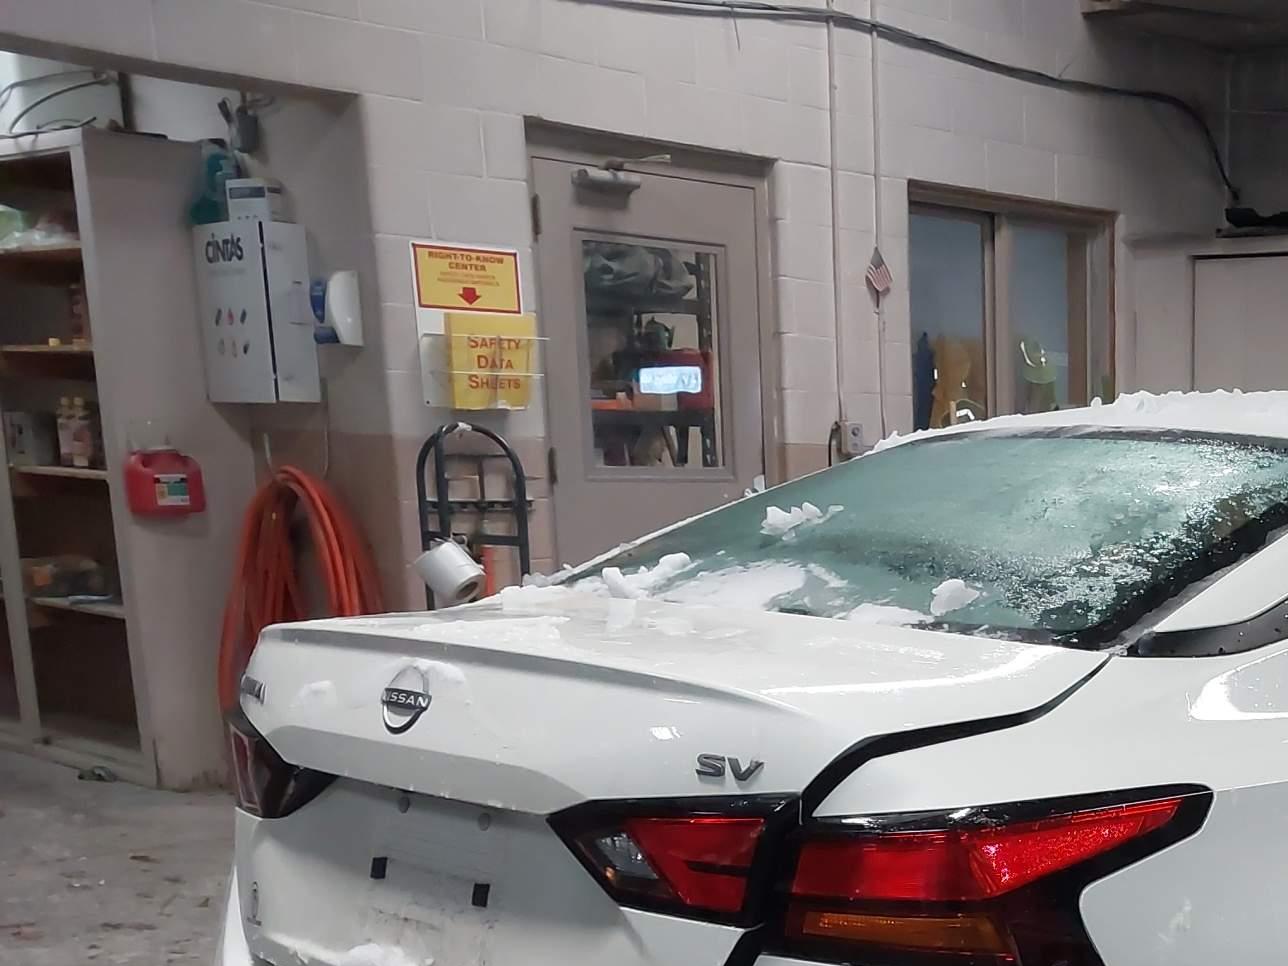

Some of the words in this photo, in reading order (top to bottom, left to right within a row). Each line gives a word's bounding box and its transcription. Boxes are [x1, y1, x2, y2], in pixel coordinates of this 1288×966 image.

[447, 261, 488, 273] CENTER
[467, 335, 522, 351] SAFETY
[476, 354, 515, 370] DATA
[695, 753, 765, 783] SV
